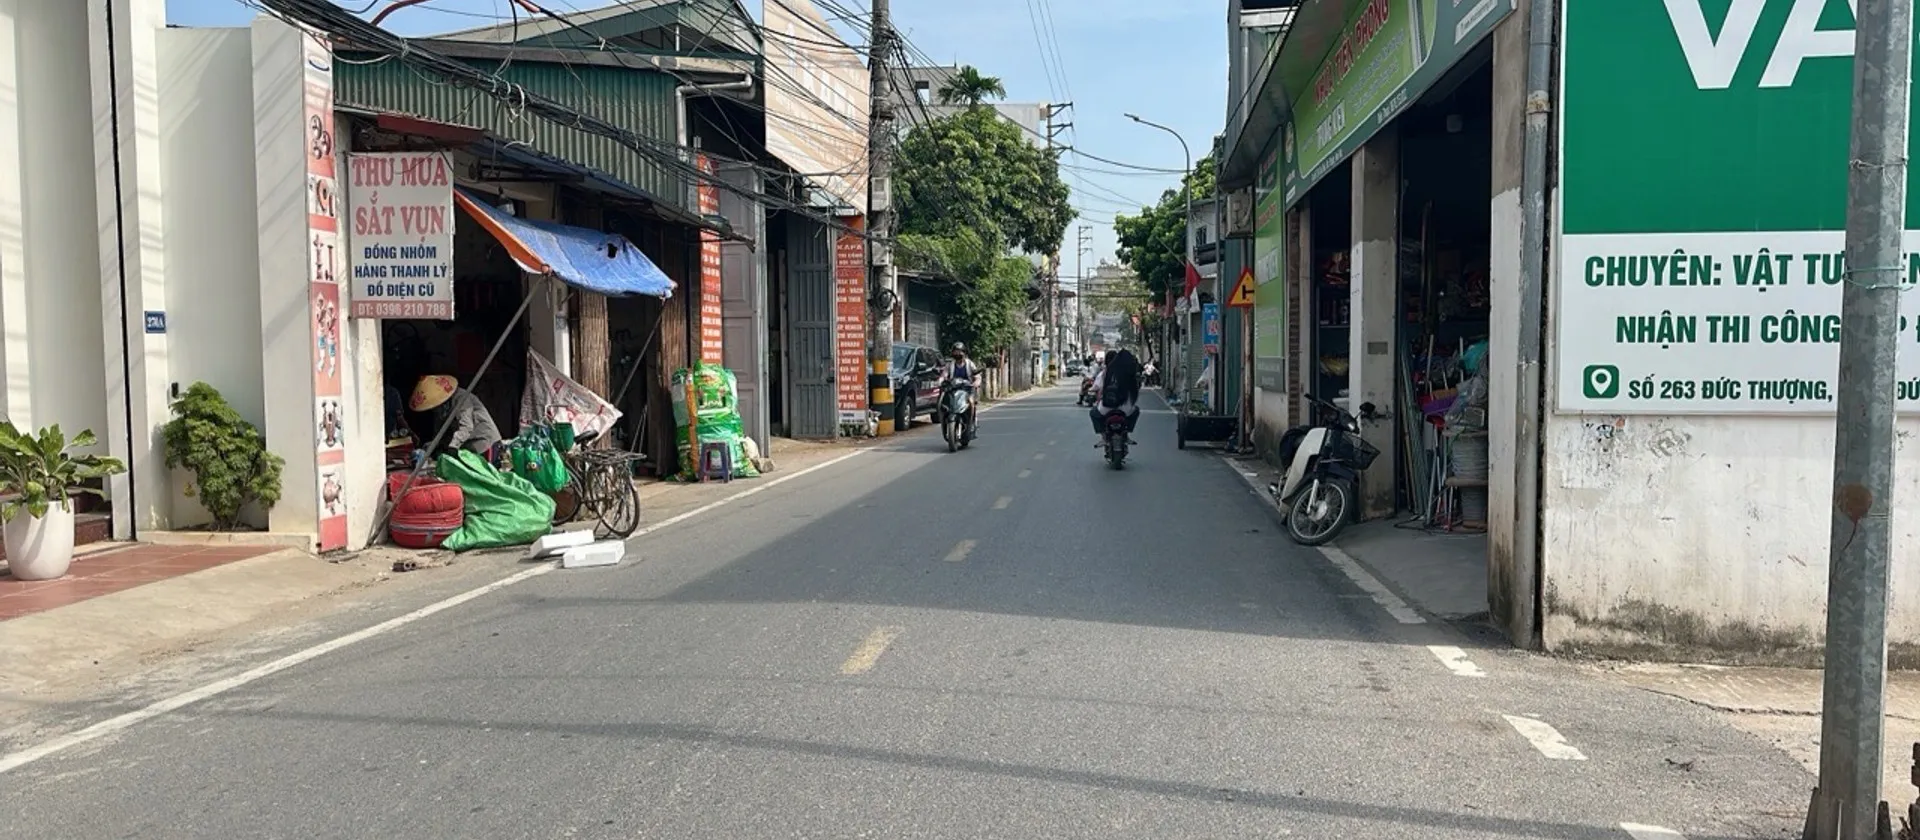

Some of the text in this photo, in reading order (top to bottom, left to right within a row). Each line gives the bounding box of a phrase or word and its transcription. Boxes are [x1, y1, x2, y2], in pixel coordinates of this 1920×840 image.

[352, 157, 448, 187] THU MUA
[400, 205, 446, 243] VỤN
[400, 244, 437, 260] NHÔM
[355, 263, 387, 278] HÀNG
[391, 265, 430, 278] THANH
[1585, 247, 1847, 292] CHUYÊN: VẬT TƯ
[387, 282, 415, 300] ĐIỆN
[419, 281, 435, 297] CŨ
[404, 303, 422, 316] 210
[426, 303, 446, 316] 788
[1616, 309, 1841, 349] NHẬN THI CÔNG
[1628, 373, 1834, 404] SỐ 263 ĐỨC THƯỢNG,
